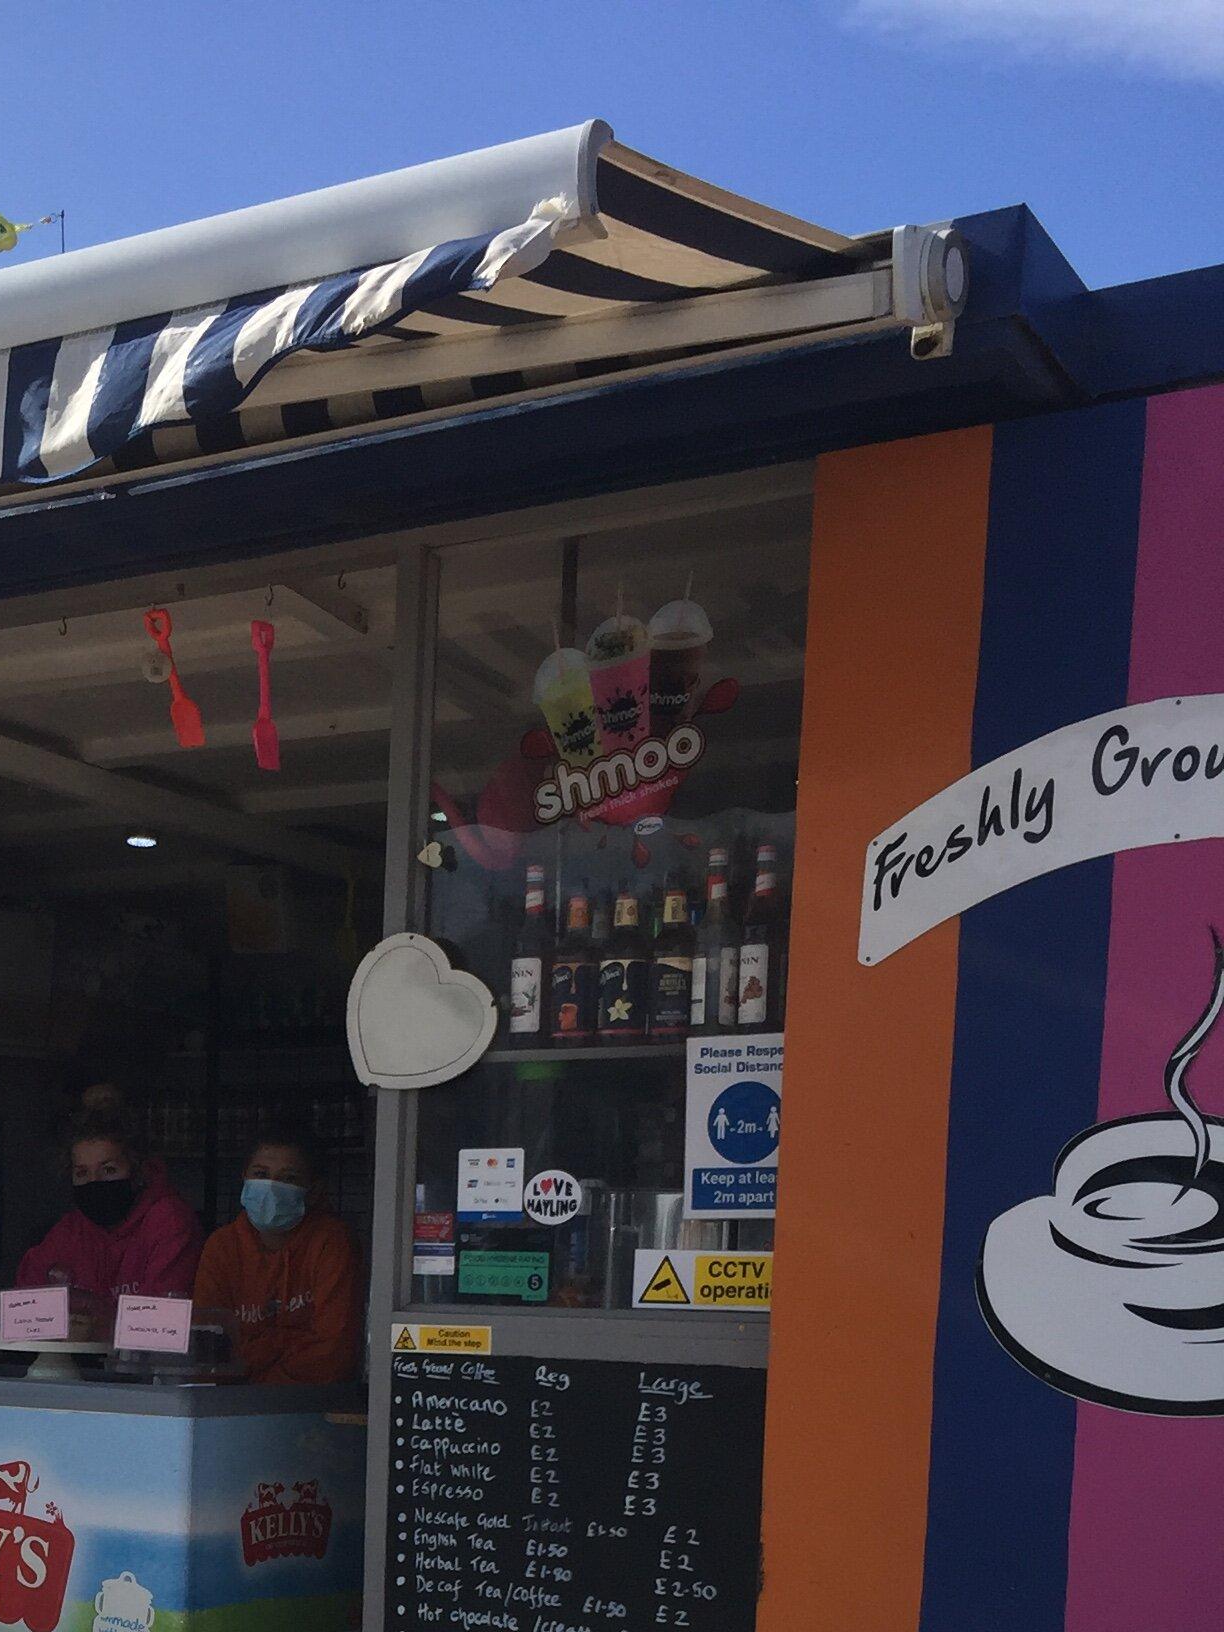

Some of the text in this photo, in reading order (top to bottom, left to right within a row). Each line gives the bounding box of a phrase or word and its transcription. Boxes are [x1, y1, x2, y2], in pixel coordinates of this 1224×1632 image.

[534, 722, 705, 823] shmoo
[873, 724, 1224, 912] Freshly Grou
[700, 1045, 784, 1058] Please Respe
[694, 1060, 783, 1074] Social Distanc
[737, 1119, 757, 1134] 2m
[700, 1170, 776, 1187] Keep at lea
[713, 1189, 775, 1206] 2m apart
[526, 1198, 578, 1217] HAYLING
[708, 1261, 765, 1278] CCTV
[700, 1282, 773, 1302] operati
[438, 1328, 471, 1338] Caution
[426, 1338, 482, 1349] Mind the step
[535, 1365, 704, 1405] Reg Large
[411, 1395, 507, 1416] Americano
[410, 1435, 501, 1463] Cappuccino
[250, 1502, 324, 1545] KELLY'S
[413, 1532, 457, 1556] English
[468, 1536, 497, 1552] Tea
[470, 1558, 500, 1575] Tea
[416, 1574, 463, 1601] Decaf
[417, 1602, 443, 1621] Hot
